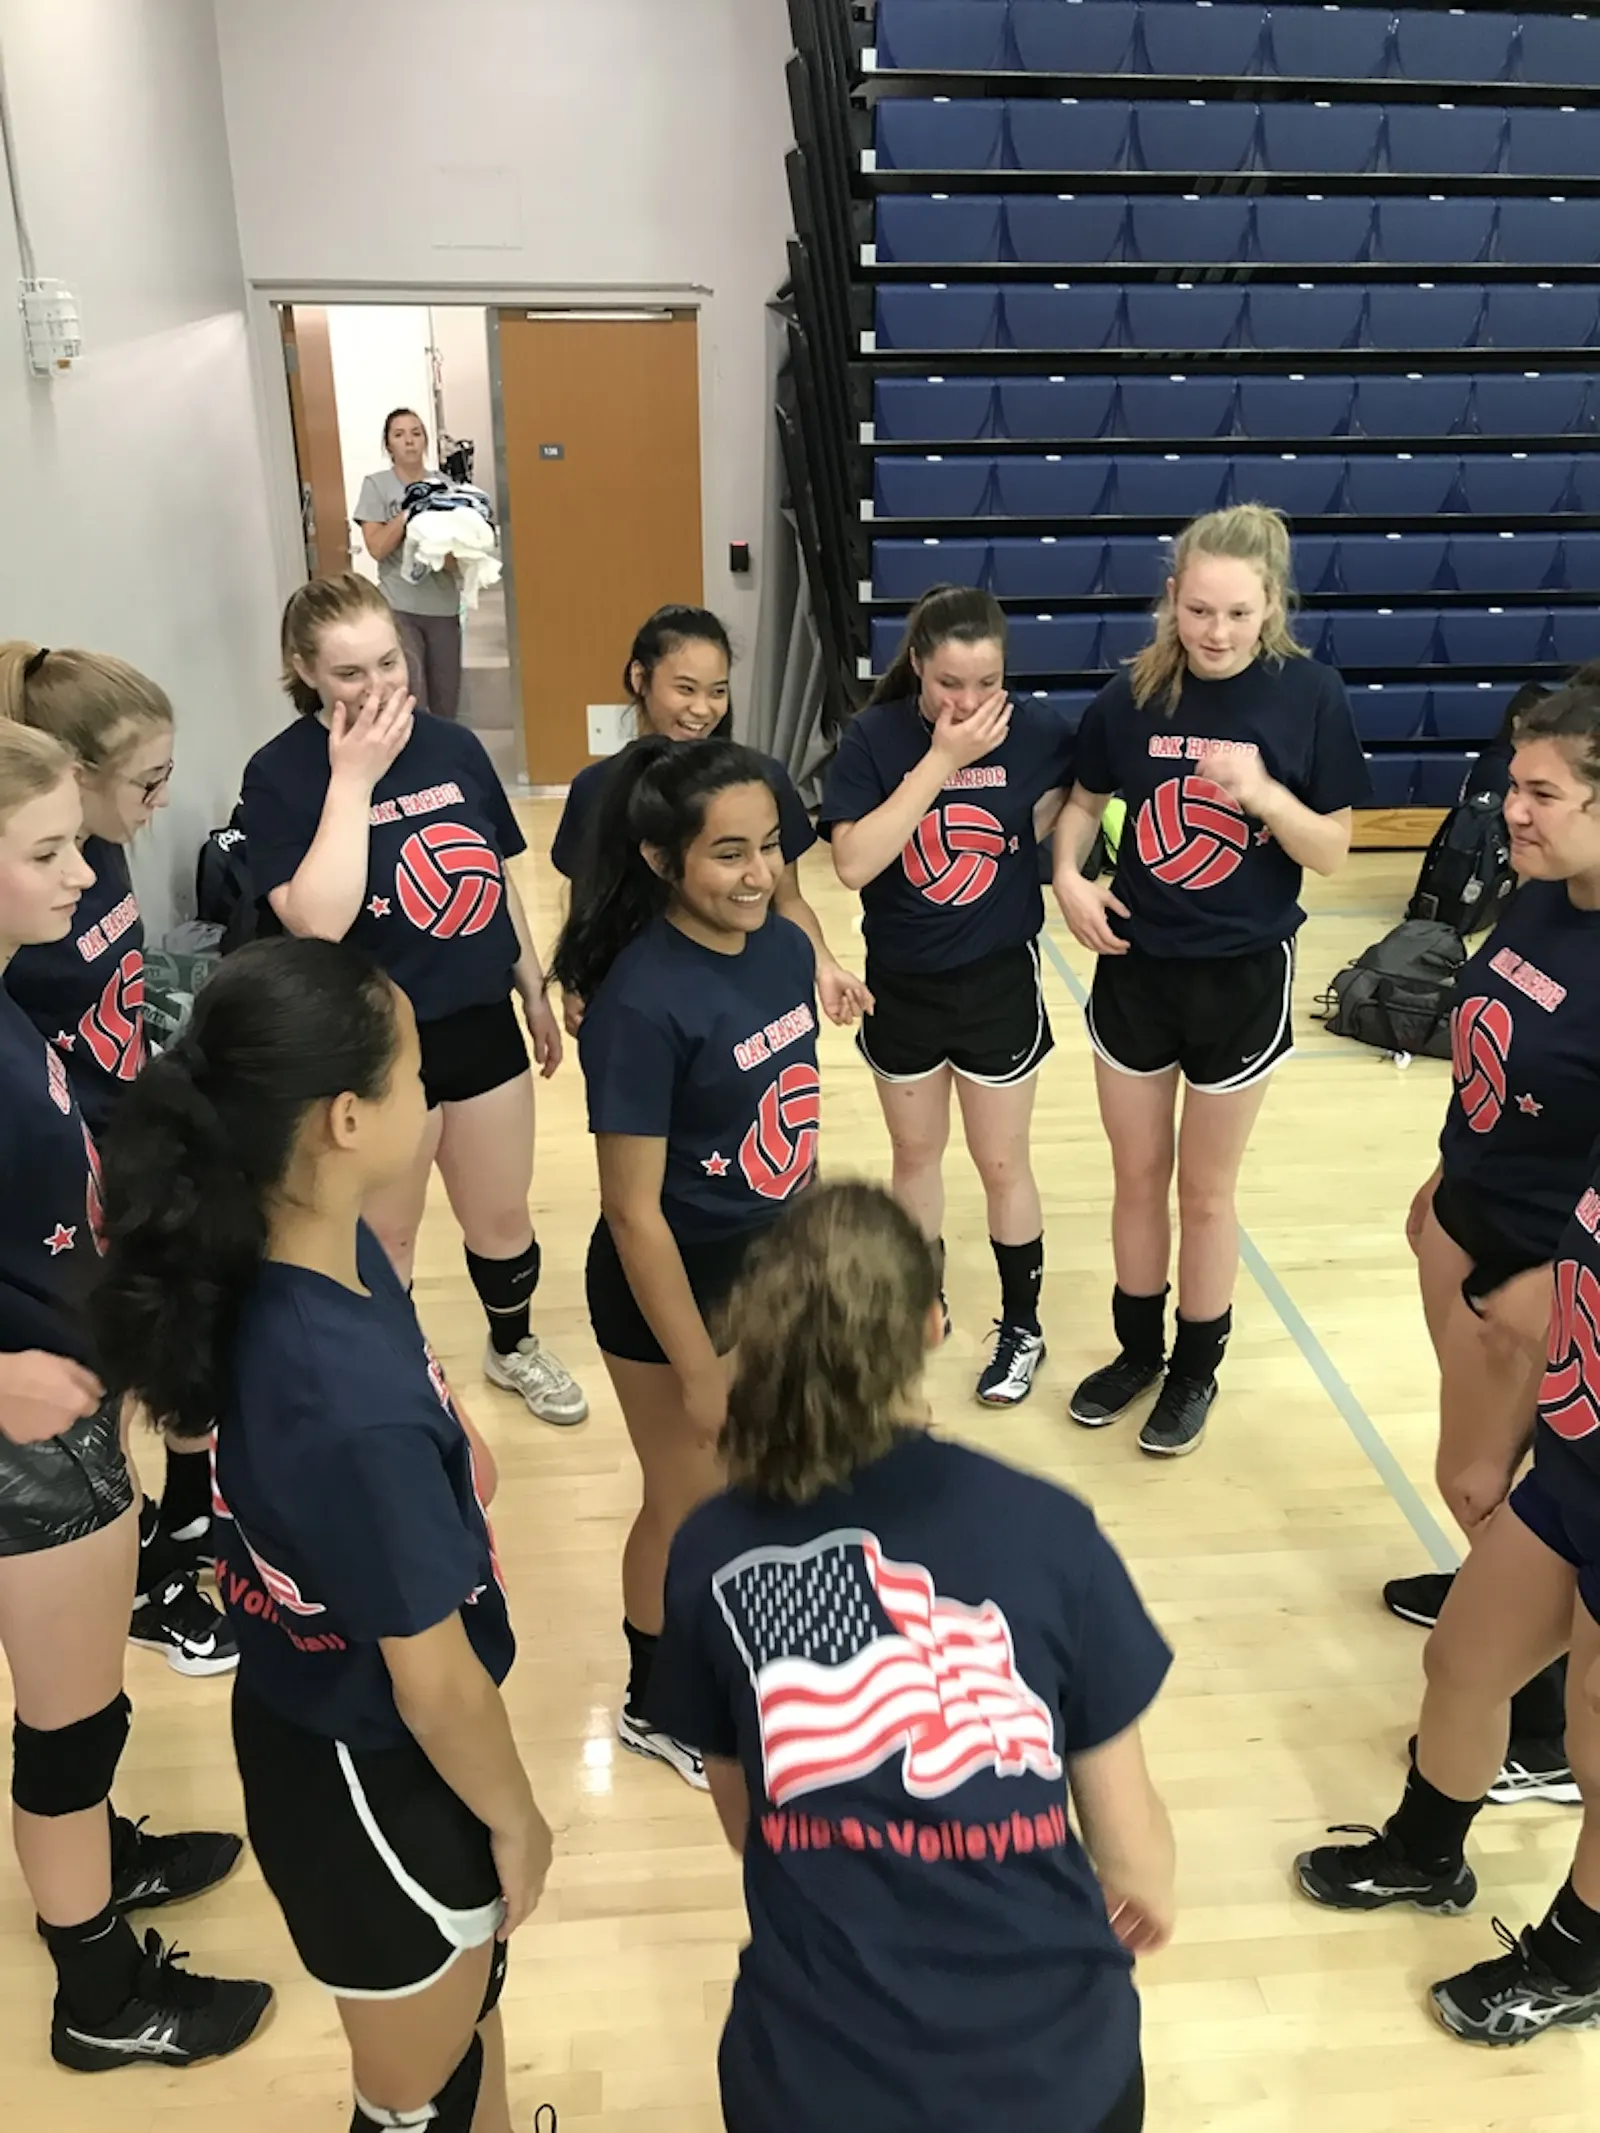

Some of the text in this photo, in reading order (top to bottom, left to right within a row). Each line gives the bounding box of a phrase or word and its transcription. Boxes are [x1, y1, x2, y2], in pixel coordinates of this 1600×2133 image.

[1148, 735, 1184, 759] OAK
[396, 782, 466, 817] HARBOR
[733, 1031, 772, 1072] OAK
[886, 1804, 1067, 1864] Volleyball
